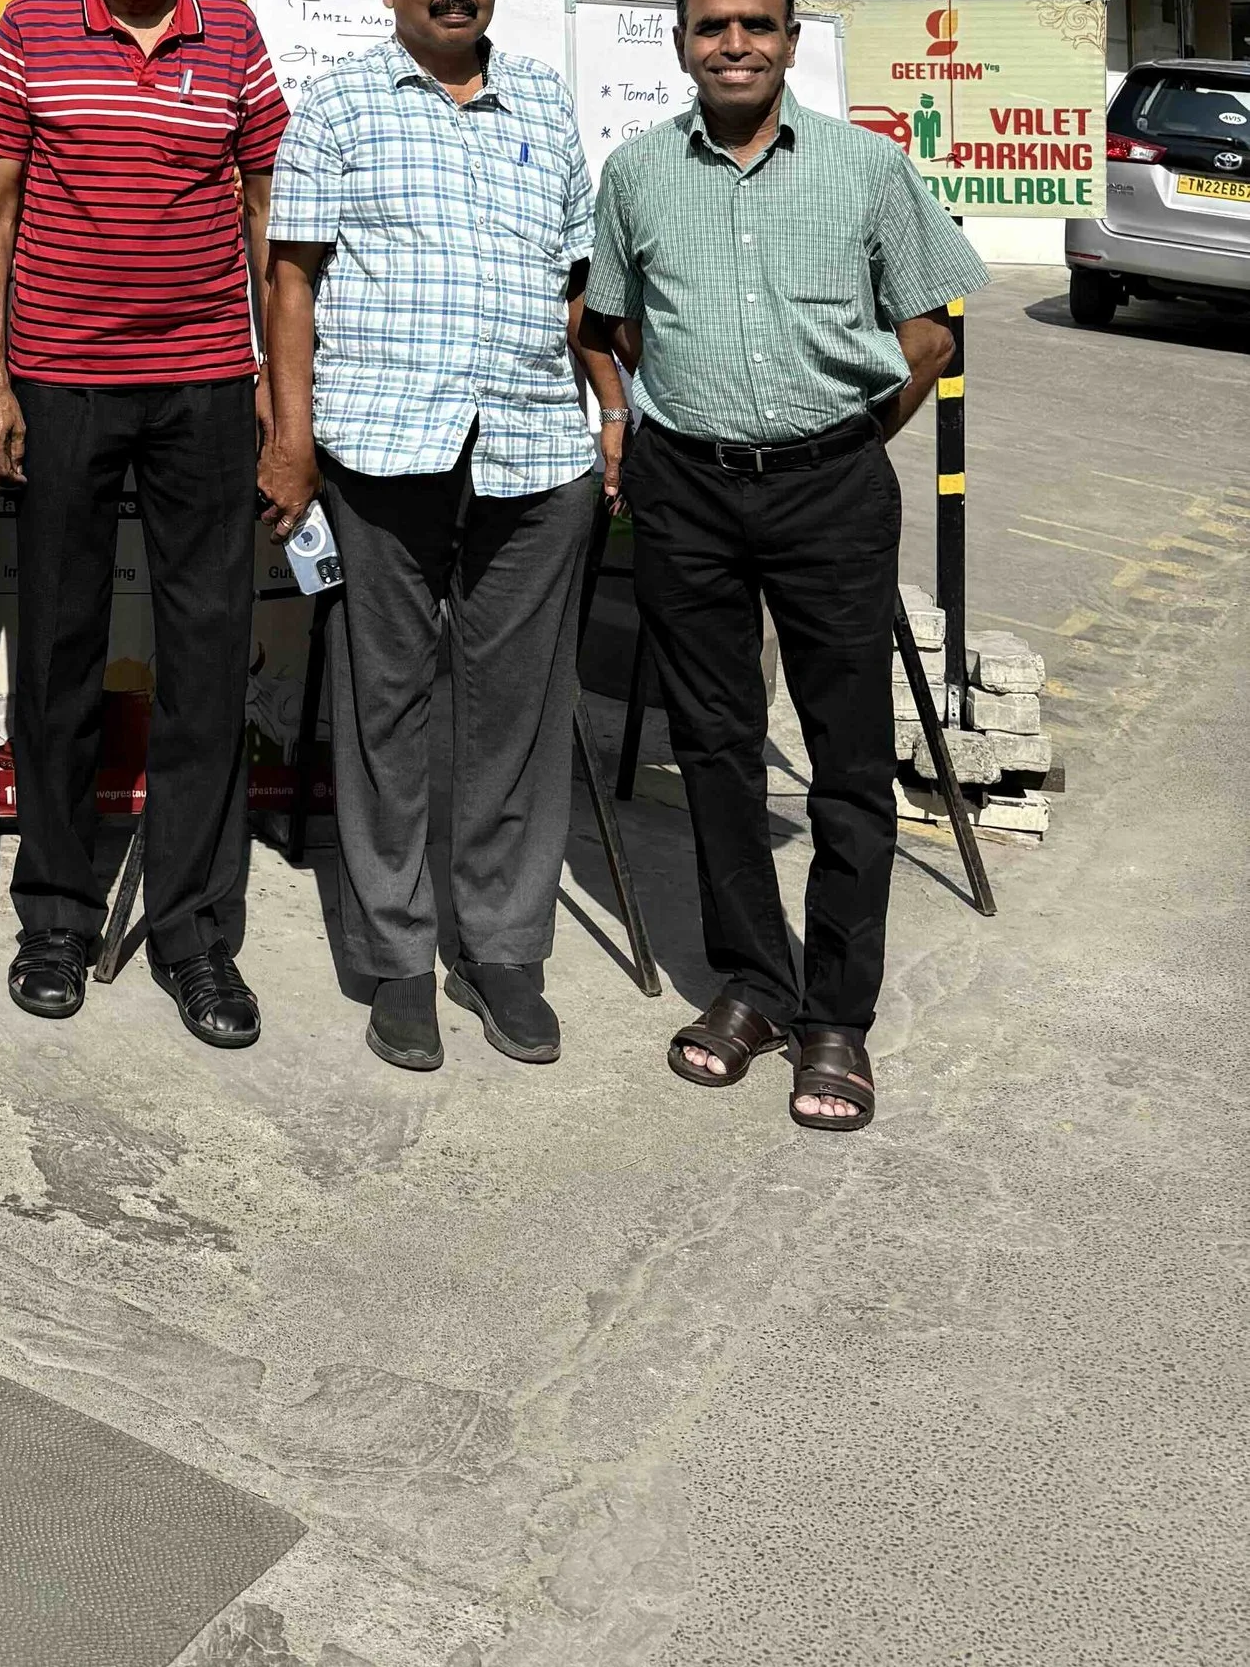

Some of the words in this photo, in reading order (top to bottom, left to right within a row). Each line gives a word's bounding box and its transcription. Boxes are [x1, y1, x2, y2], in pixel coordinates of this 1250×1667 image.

[360, 15, 394, 27] NAD
[617, 10, 664, 39] North
[891, 62, 984, 80] GEETHAM
[984, 63, 1000, 73] Veg
[617, 80, 670, 105] Tomato
[989, 107, 1093, 136] VALET
[1222, 114, 1242, 123] AVIS
[952, 142, 1093, 171] PARKING
